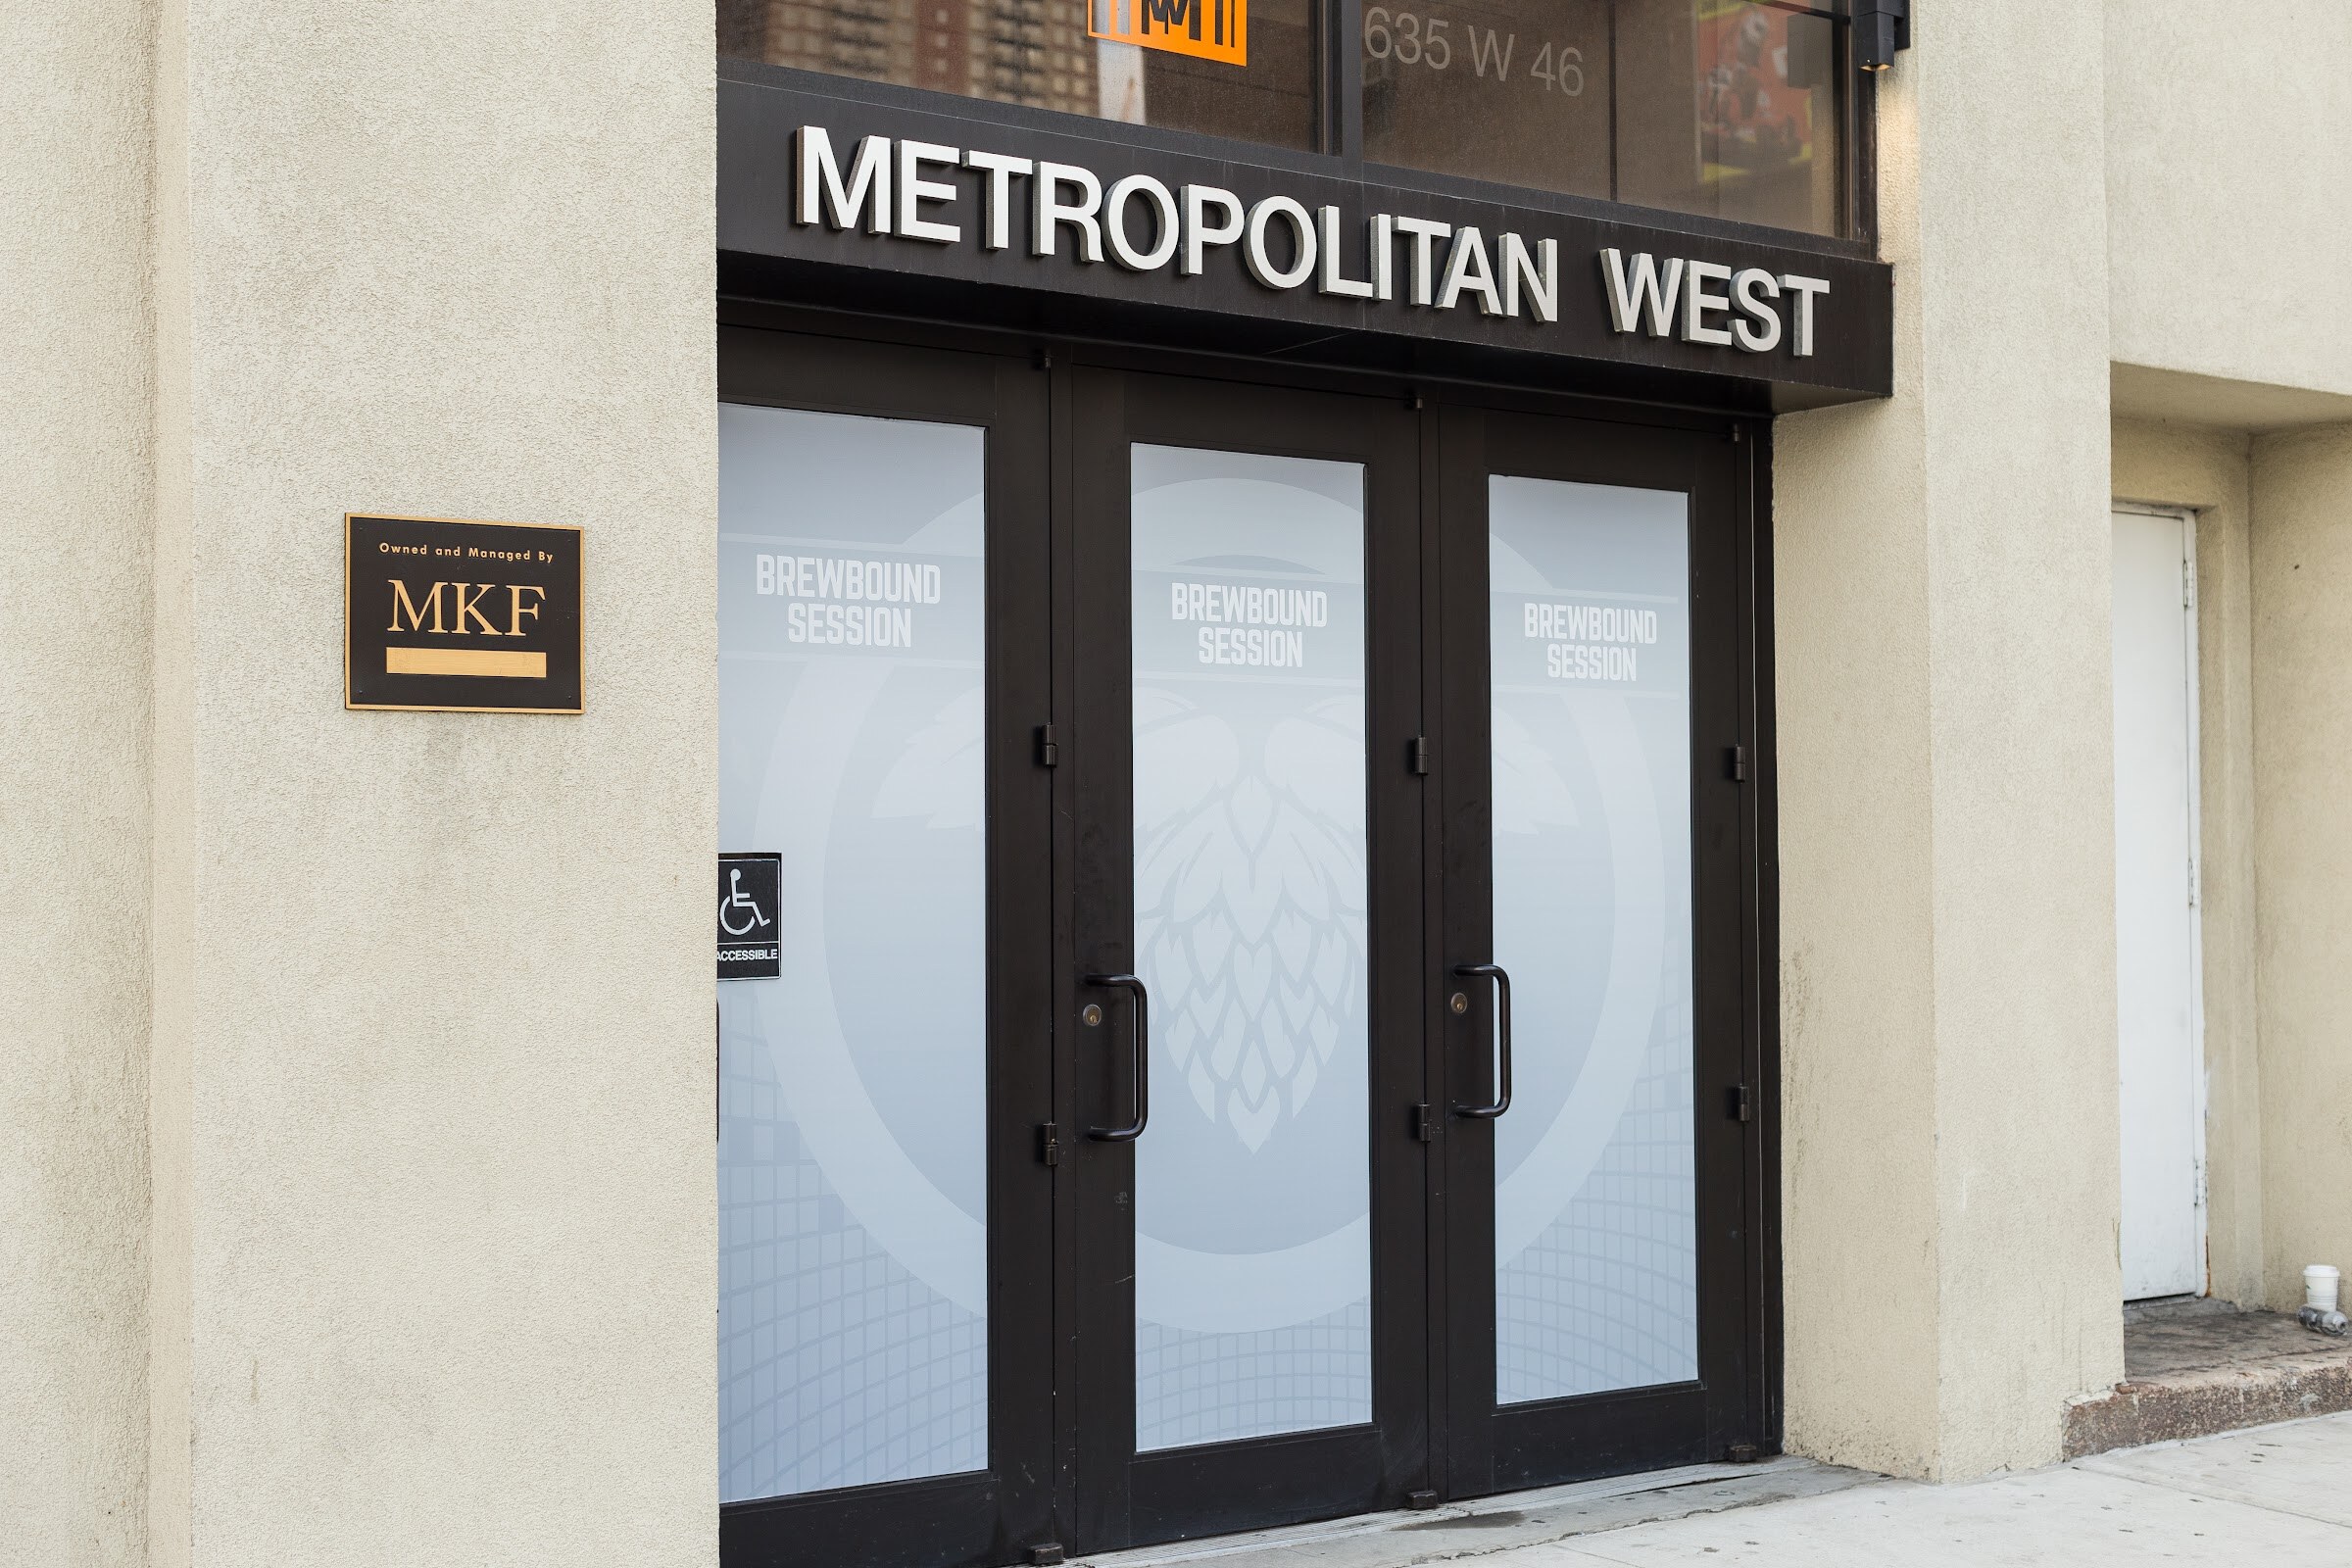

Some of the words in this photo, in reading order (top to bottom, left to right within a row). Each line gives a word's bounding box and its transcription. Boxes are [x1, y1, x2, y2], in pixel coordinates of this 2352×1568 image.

[1364, 7, 1451, 70] 635
[1468, 24, 1515, 82] W
[1530, 41, 1584, 97] 46
[796, 124, 1558, 322] METROPOLITAN
[1599, 248, 1831, 358] WEST
[378, 542, 427, 556] Owned
[435, 546, 461, 557] and
[468, 547, 530, 563] Managed
[538, 551, 554, 564] By
[757, 554, 941, 605] BREWBOUND
[387, 579, 546, 637] MKF
[788, 602, 911, 648] SESSION
[1171, 582, 1328, 628] BREWBOUND
[1524, 602, 1657, 645] BREWBOUND
[1198, 626, 1303, 668] SESSION
[1546, 643, 1637, 682] SESSION
